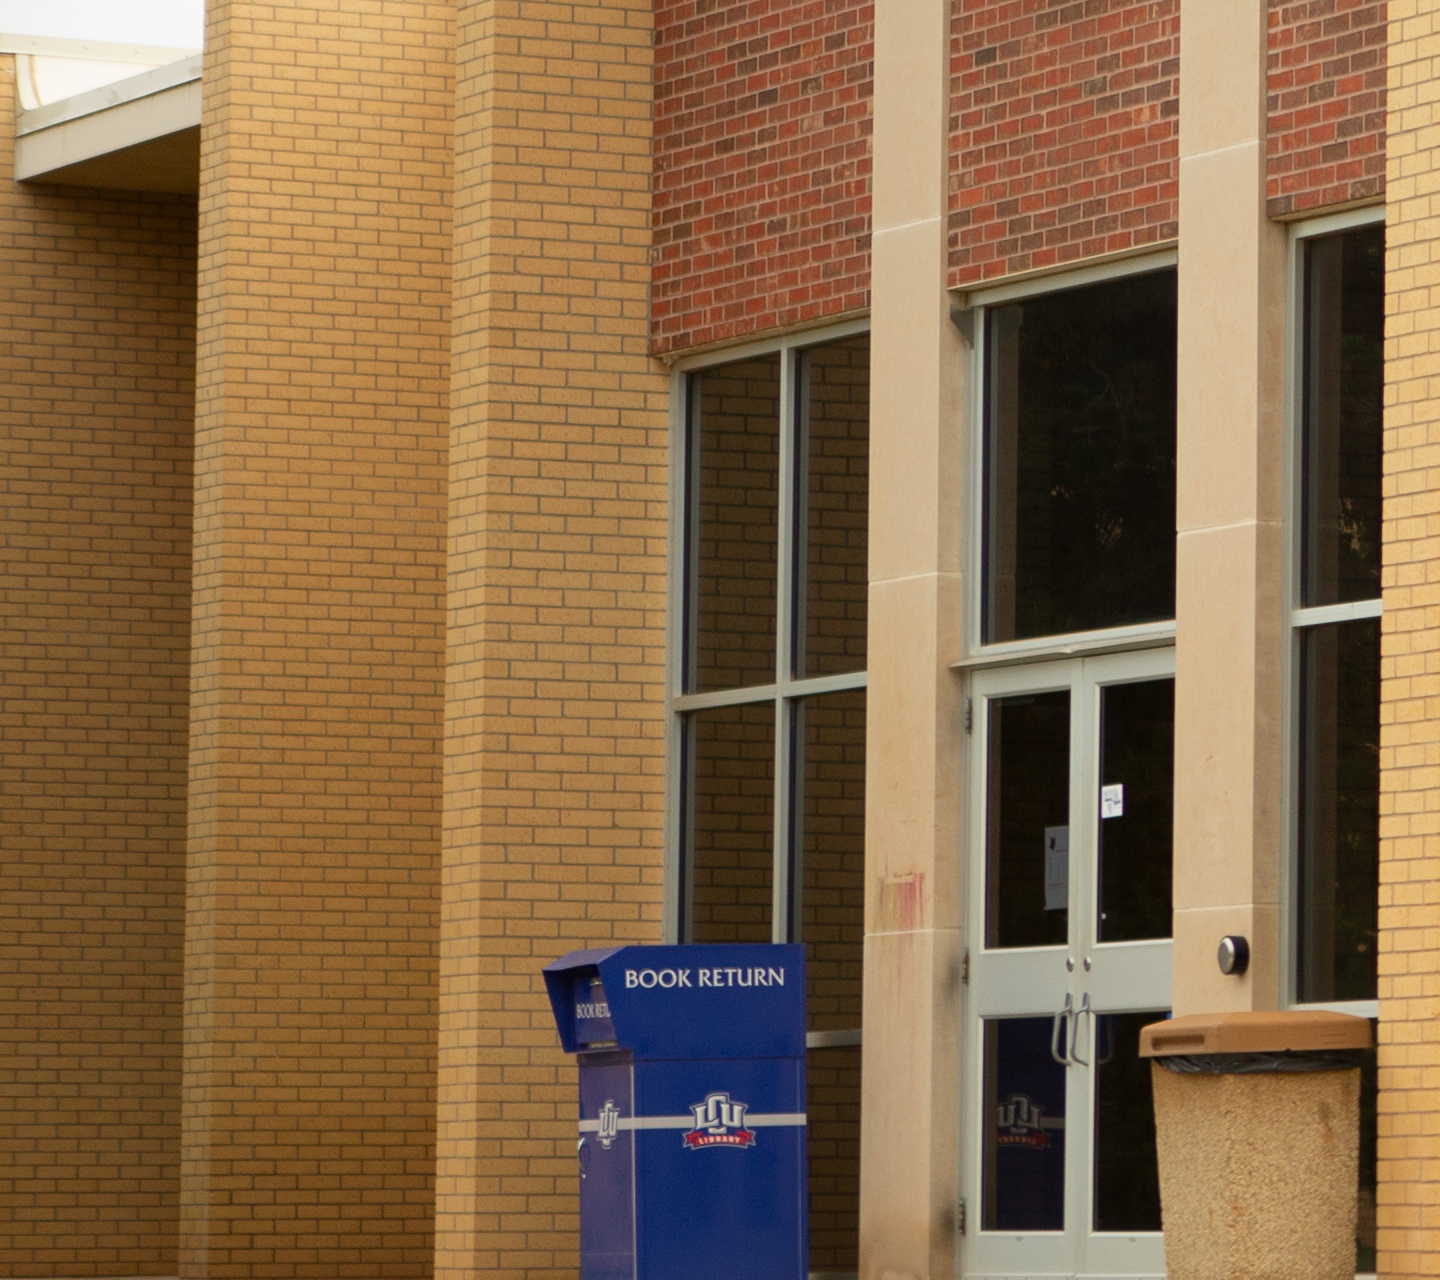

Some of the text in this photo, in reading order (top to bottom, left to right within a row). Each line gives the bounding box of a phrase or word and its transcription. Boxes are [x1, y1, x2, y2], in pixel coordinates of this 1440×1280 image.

[624, 966, 785, 990] BOOK RETURN
[576, 1002, 595, 1019] BOOK
[698, 1135, 742, 1145] LIBRARY
